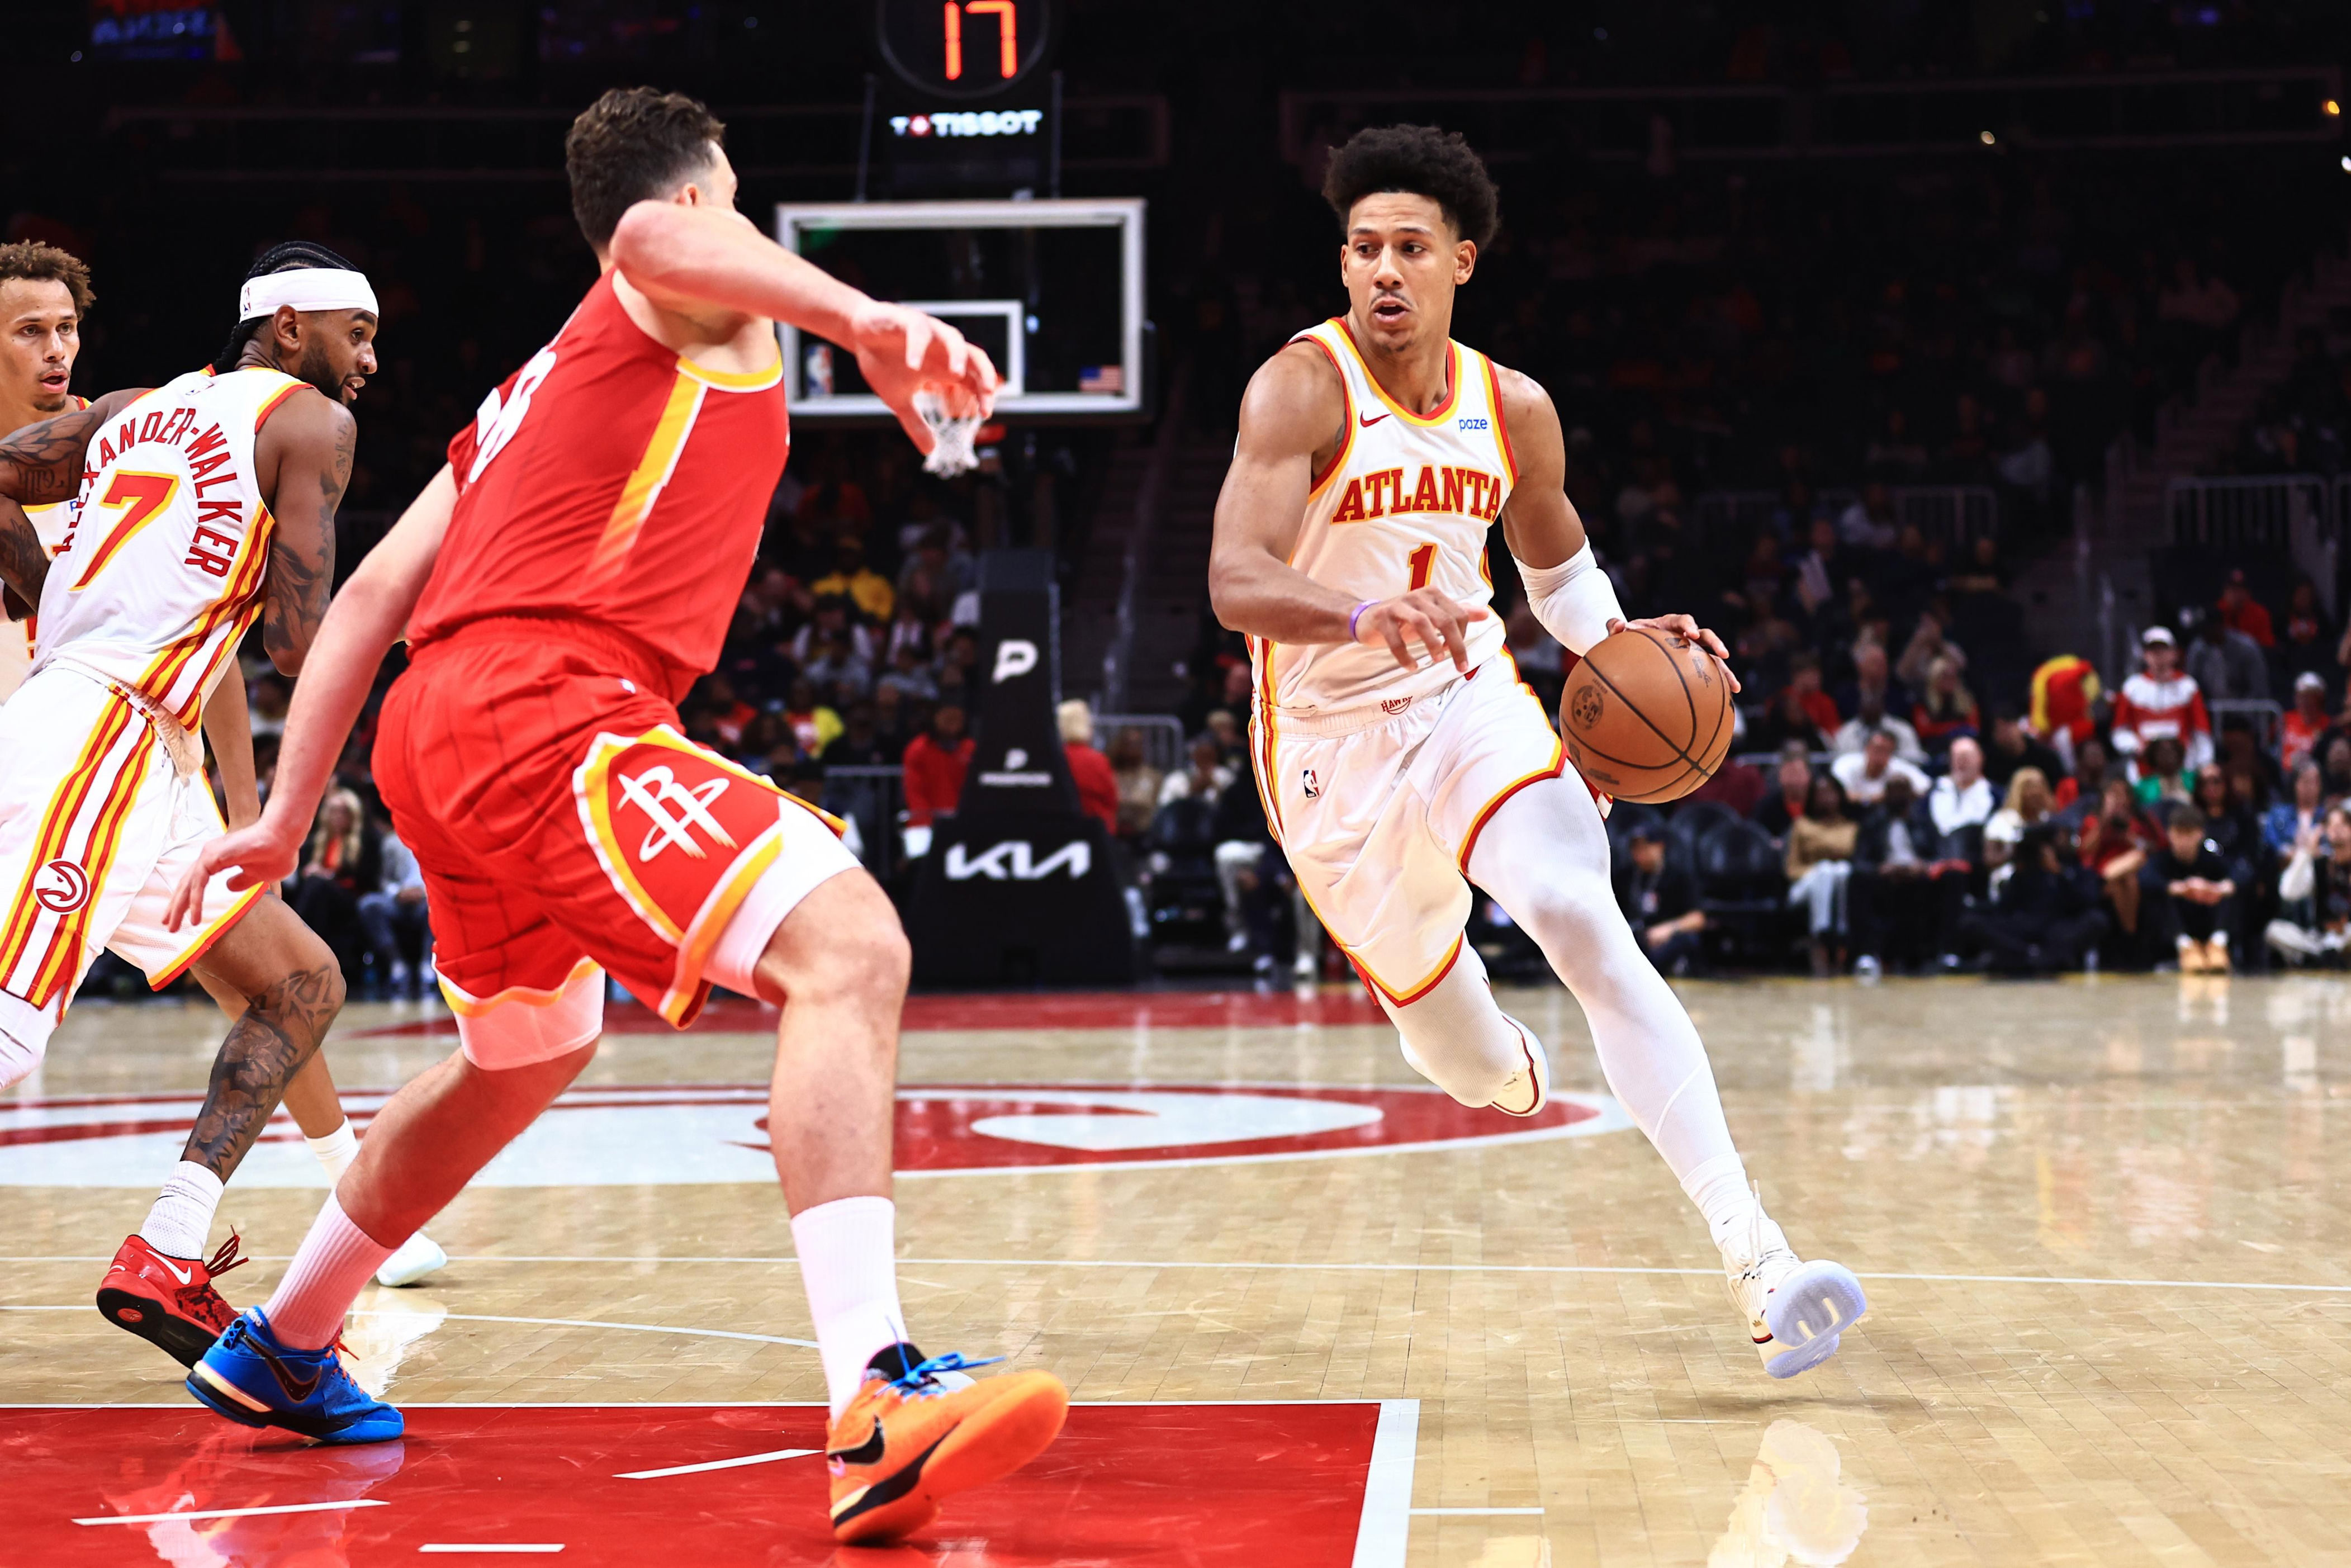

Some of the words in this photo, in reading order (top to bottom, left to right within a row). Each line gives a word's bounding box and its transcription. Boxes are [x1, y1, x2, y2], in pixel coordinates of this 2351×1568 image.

[945, 1, 1017, 80] 17
[930, 110, 1043, 137] TISSOT
[1459, 419, 1487, 433] paze
[1330, 465, 1501, 524] ATLANTA
[68, 469, 180, 591] 7
[1407, 542, 1438, 593] 1
[945, 840, 1091, 881] KIA
